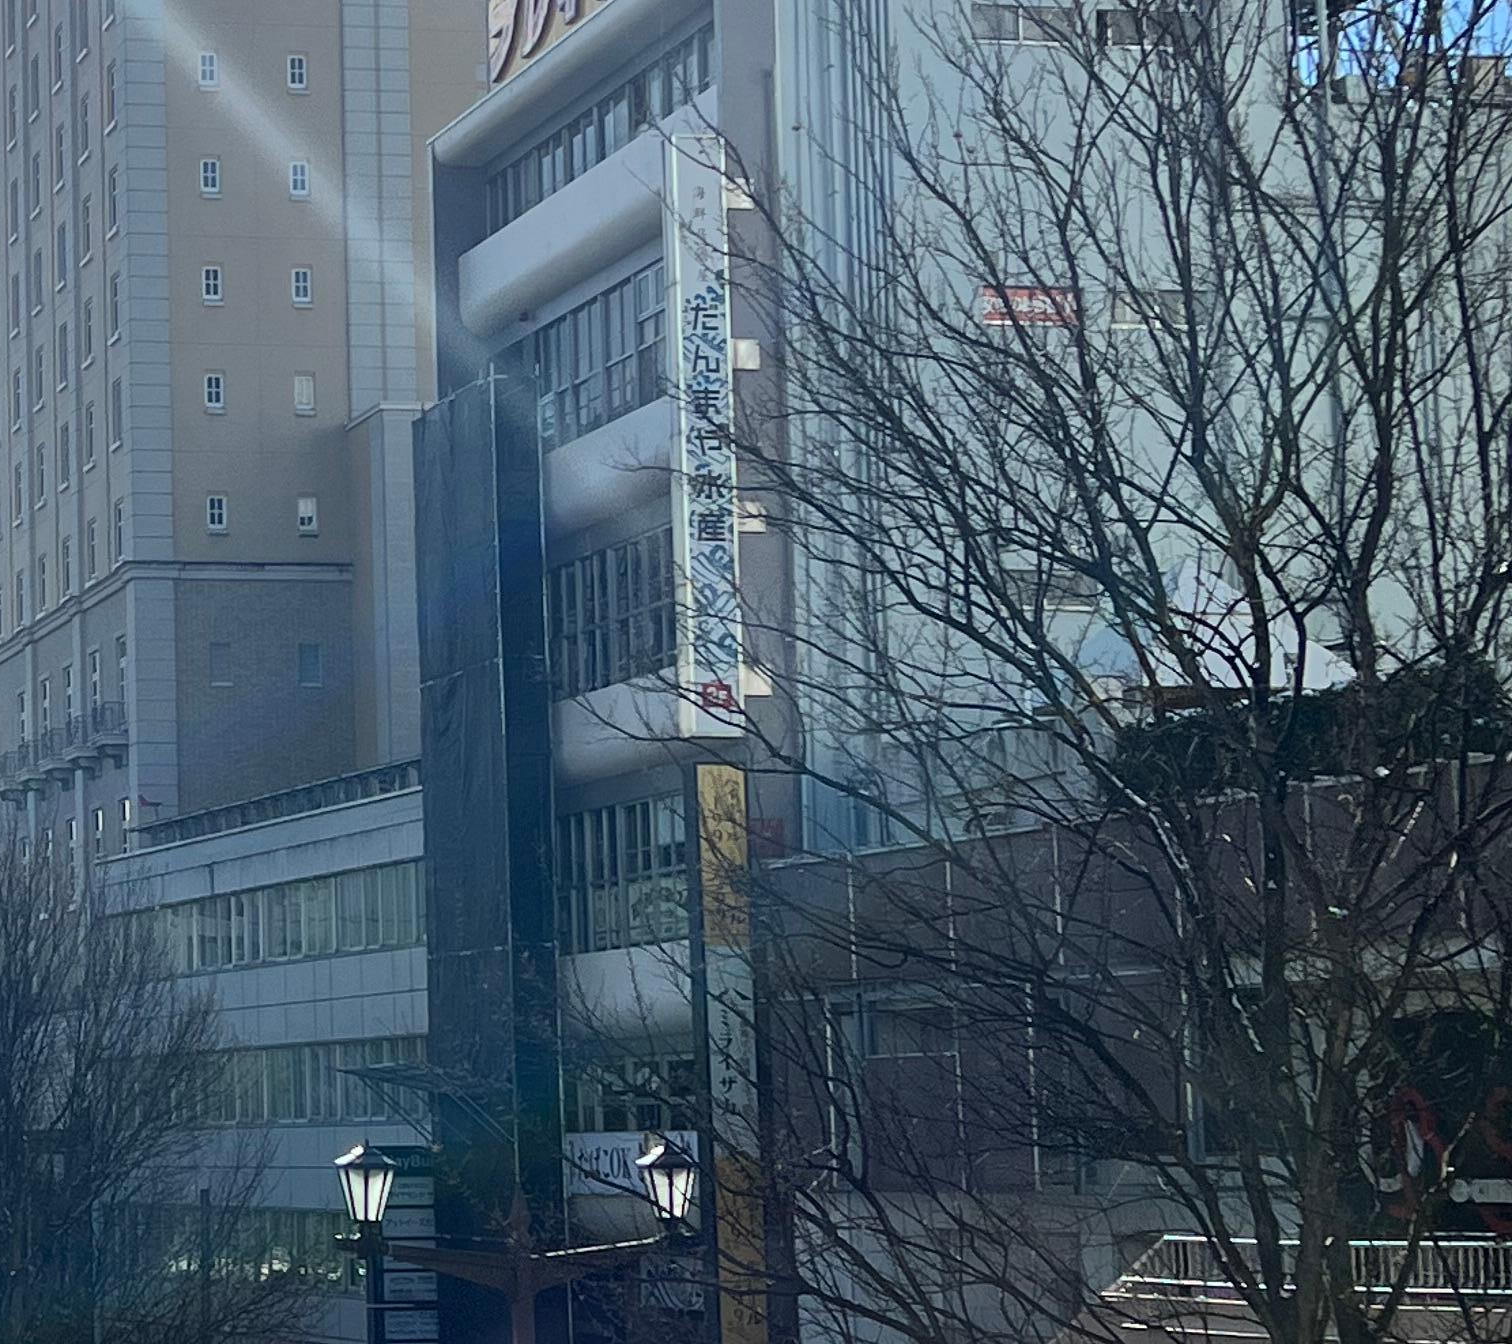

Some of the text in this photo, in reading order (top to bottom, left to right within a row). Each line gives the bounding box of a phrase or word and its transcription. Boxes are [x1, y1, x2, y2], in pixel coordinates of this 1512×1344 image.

[690, 301, 727, 543] だんまや水産
